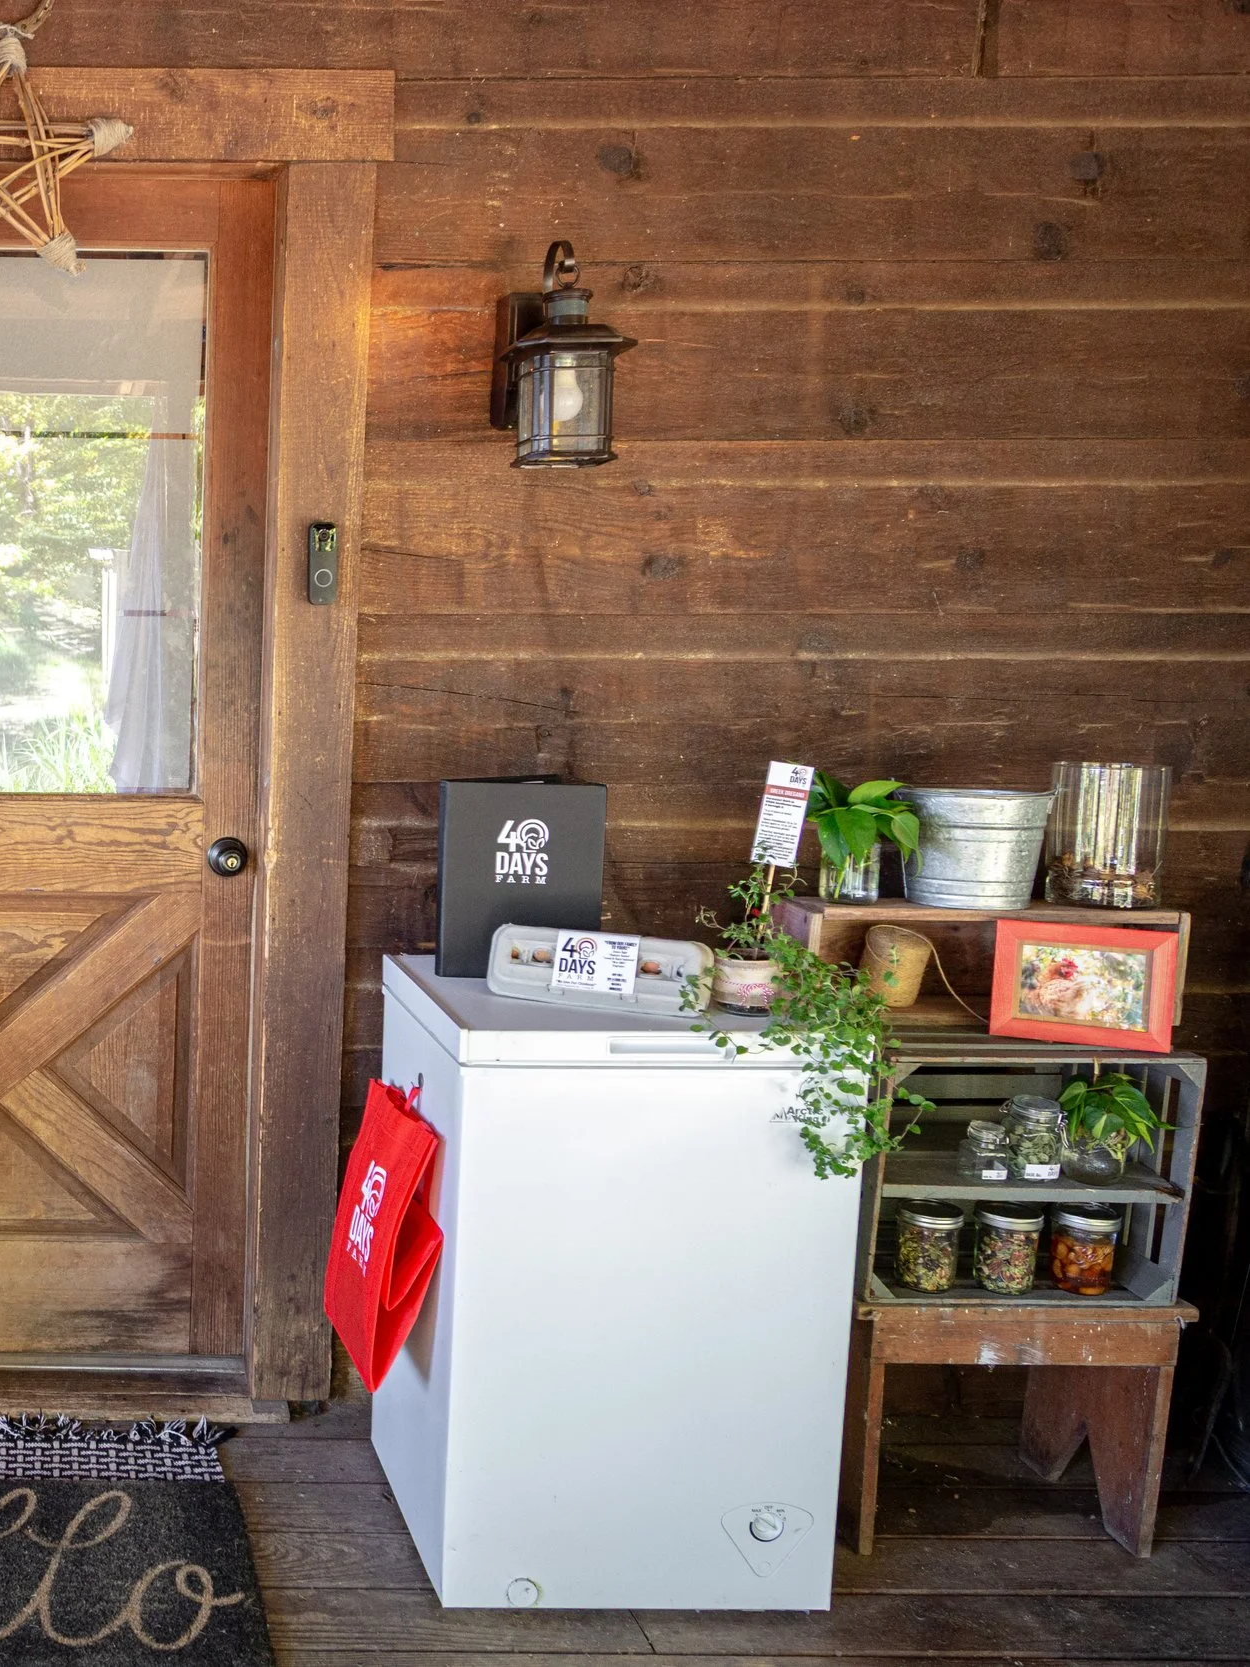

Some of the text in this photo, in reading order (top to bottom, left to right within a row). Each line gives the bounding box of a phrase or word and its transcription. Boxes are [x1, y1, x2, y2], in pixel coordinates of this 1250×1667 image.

[789, 775, 807, 785] DAYS
[495, 852, 549, 876] DAYS
[495, 875, 547, 885] FARM
[558, 958, 596, 975] DAYS
[558, 973, 594, 981] FARM
[349, 1205, 375, 1263] DAYS
